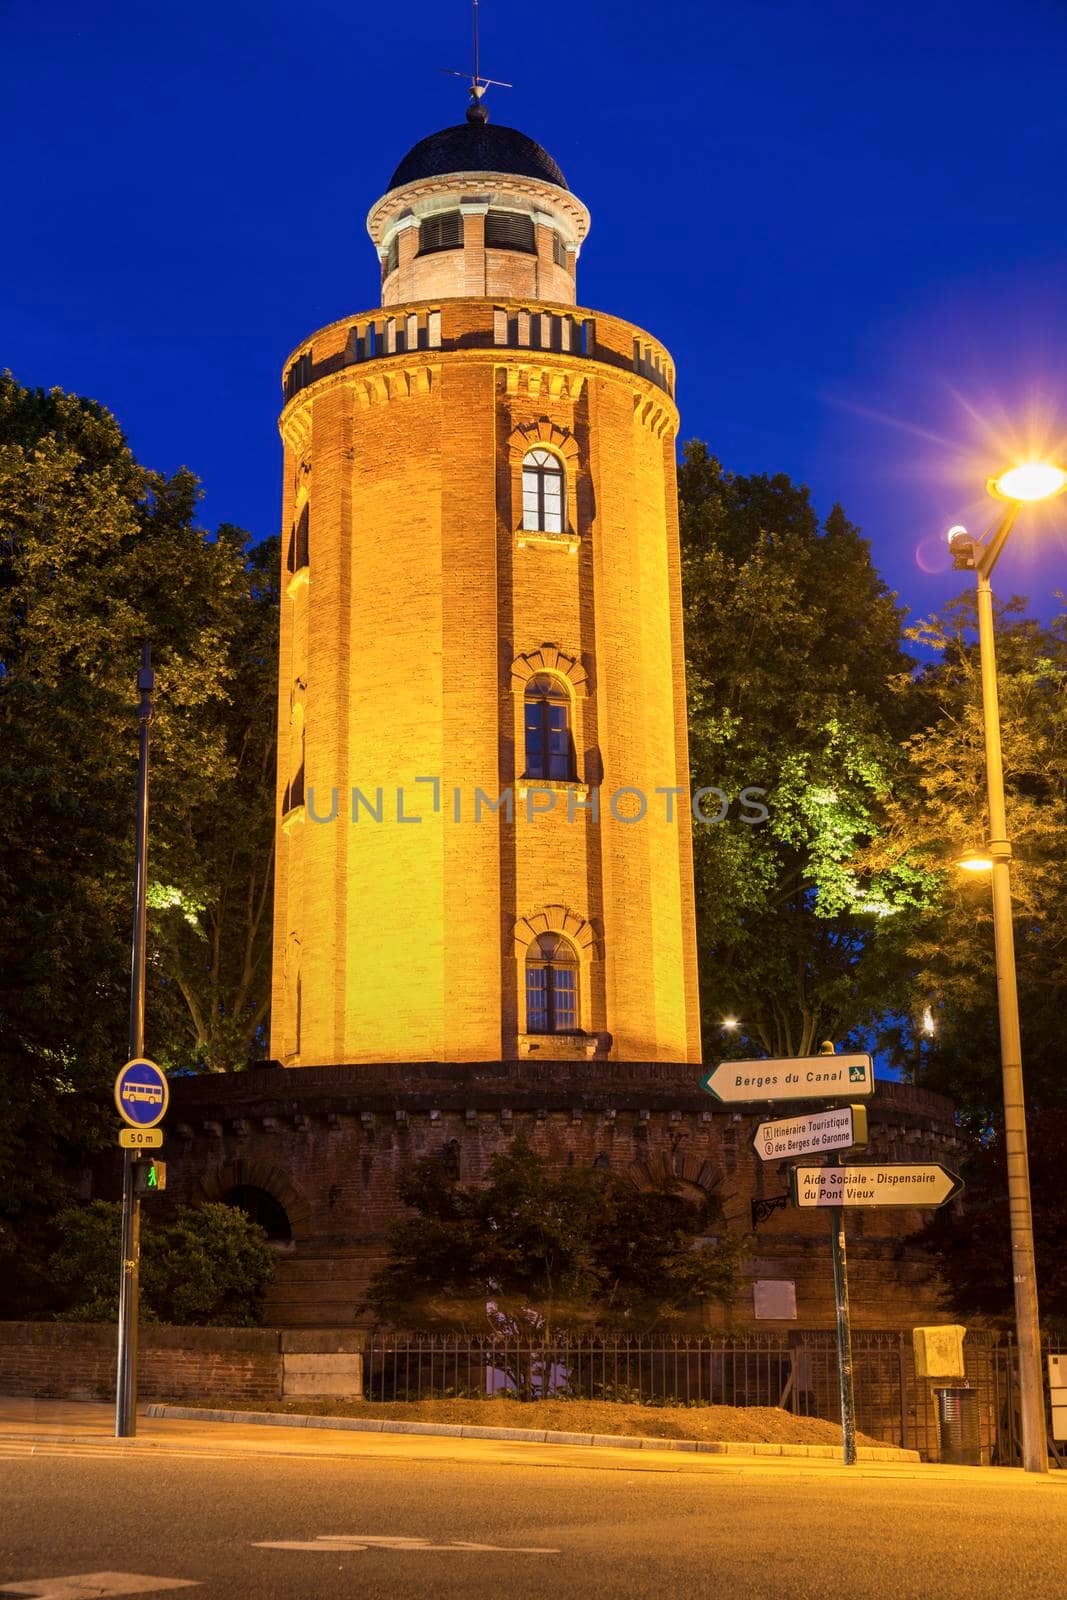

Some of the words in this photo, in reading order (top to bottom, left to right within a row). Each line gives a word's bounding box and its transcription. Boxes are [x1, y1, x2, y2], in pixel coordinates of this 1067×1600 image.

[735, 1075, 778, 1087] Berges
[785, 1073, 799, 1083] du
[806, 1070, 842, 1081] Canal
[773, 1123, 806, 1138] Itinéraire
[808, 1117, 849, 1131] Touristique
[130, 1133, 143, 1143] 50
[145, 1135, 153, 1143] m
[775, 1142, 786, 1152] des
[787, 1139, 810, 1151] Berges
[811, 1137, 820, 1146] de
[822, 1132, 849, 1144] Garonne
[803, 1174, 826, 1185] Aide
[830, 1174, 867, 1185] Sociale
[877, 1173, 936, 1186] Dispensaire
[804, 1189, 816, 1200] du
[819, 1189, 843, 1199] Pont
[846, 1188, 875, 1199] Vieux
